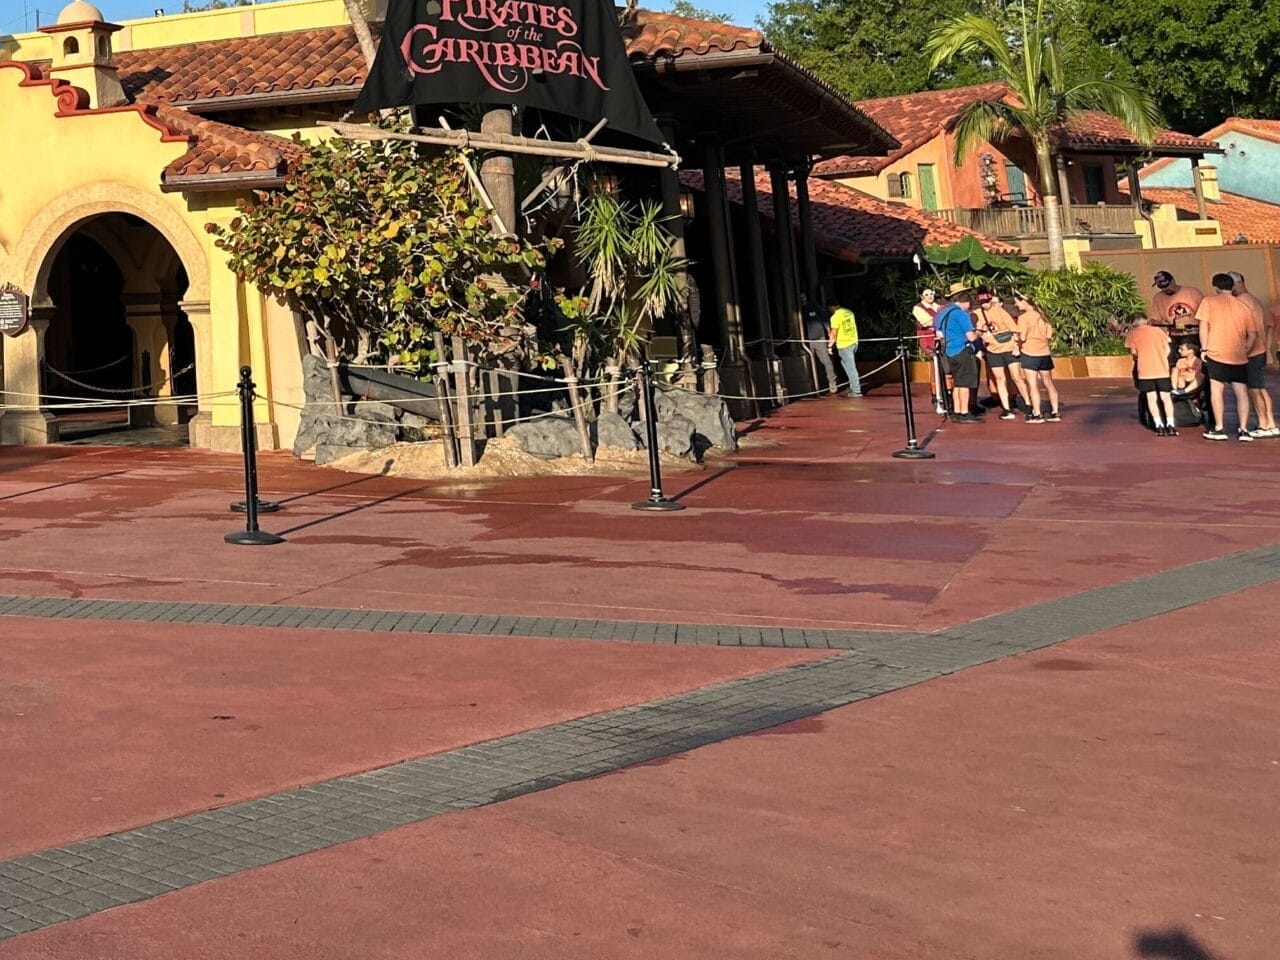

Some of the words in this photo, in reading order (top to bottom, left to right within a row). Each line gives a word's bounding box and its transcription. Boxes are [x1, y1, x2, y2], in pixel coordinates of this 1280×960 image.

[506, 26, 523, 42] of
[524, 27, 543, 42] the
[400, 24, 611, 93] CARIBBEAN
